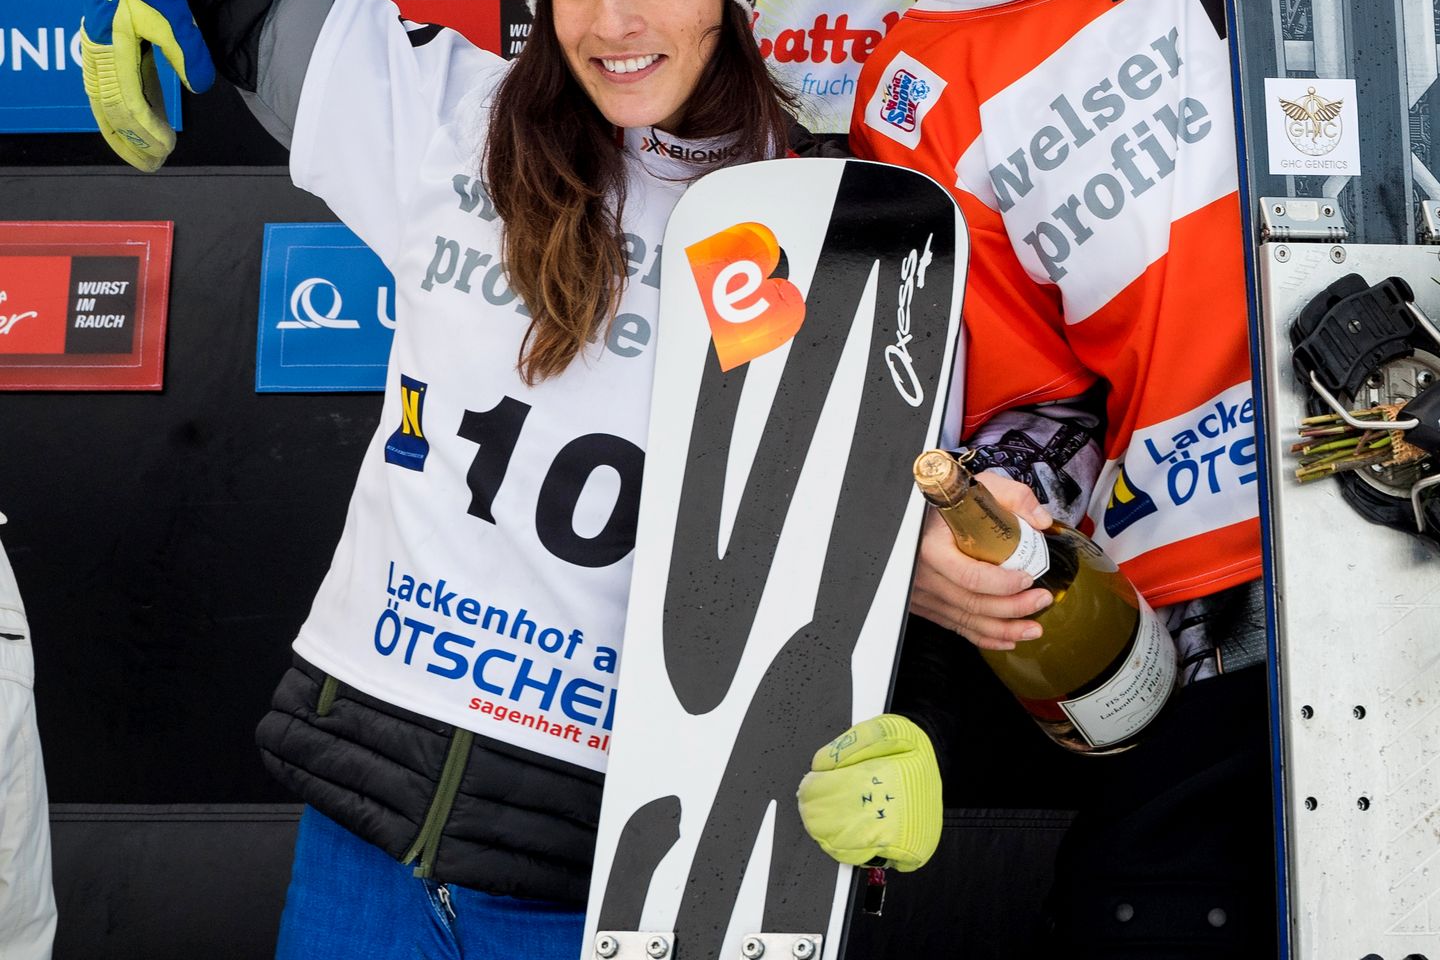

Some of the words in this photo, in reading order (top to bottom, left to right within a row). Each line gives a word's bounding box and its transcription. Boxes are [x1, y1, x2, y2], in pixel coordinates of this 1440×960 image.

[801, 72, 855, 96] fruch
[988, 24, 1186, 215] welser
[1280, 159, 1302, 169] GHC
[1304, 159, 1348, 170] GENETICS
[1023, 94, 1214, 283] profile
[76, 298, 96, 312] IM
[78, 281, 129, 295] WURST
[74, 315, 125, 329] RAUCH
[456, 394, 646, 569] 10
[386, 561, 584, 660] Lackenhof
[593, 644, 616, 675] a
[468, 696, 583, 745] sagenhaft
